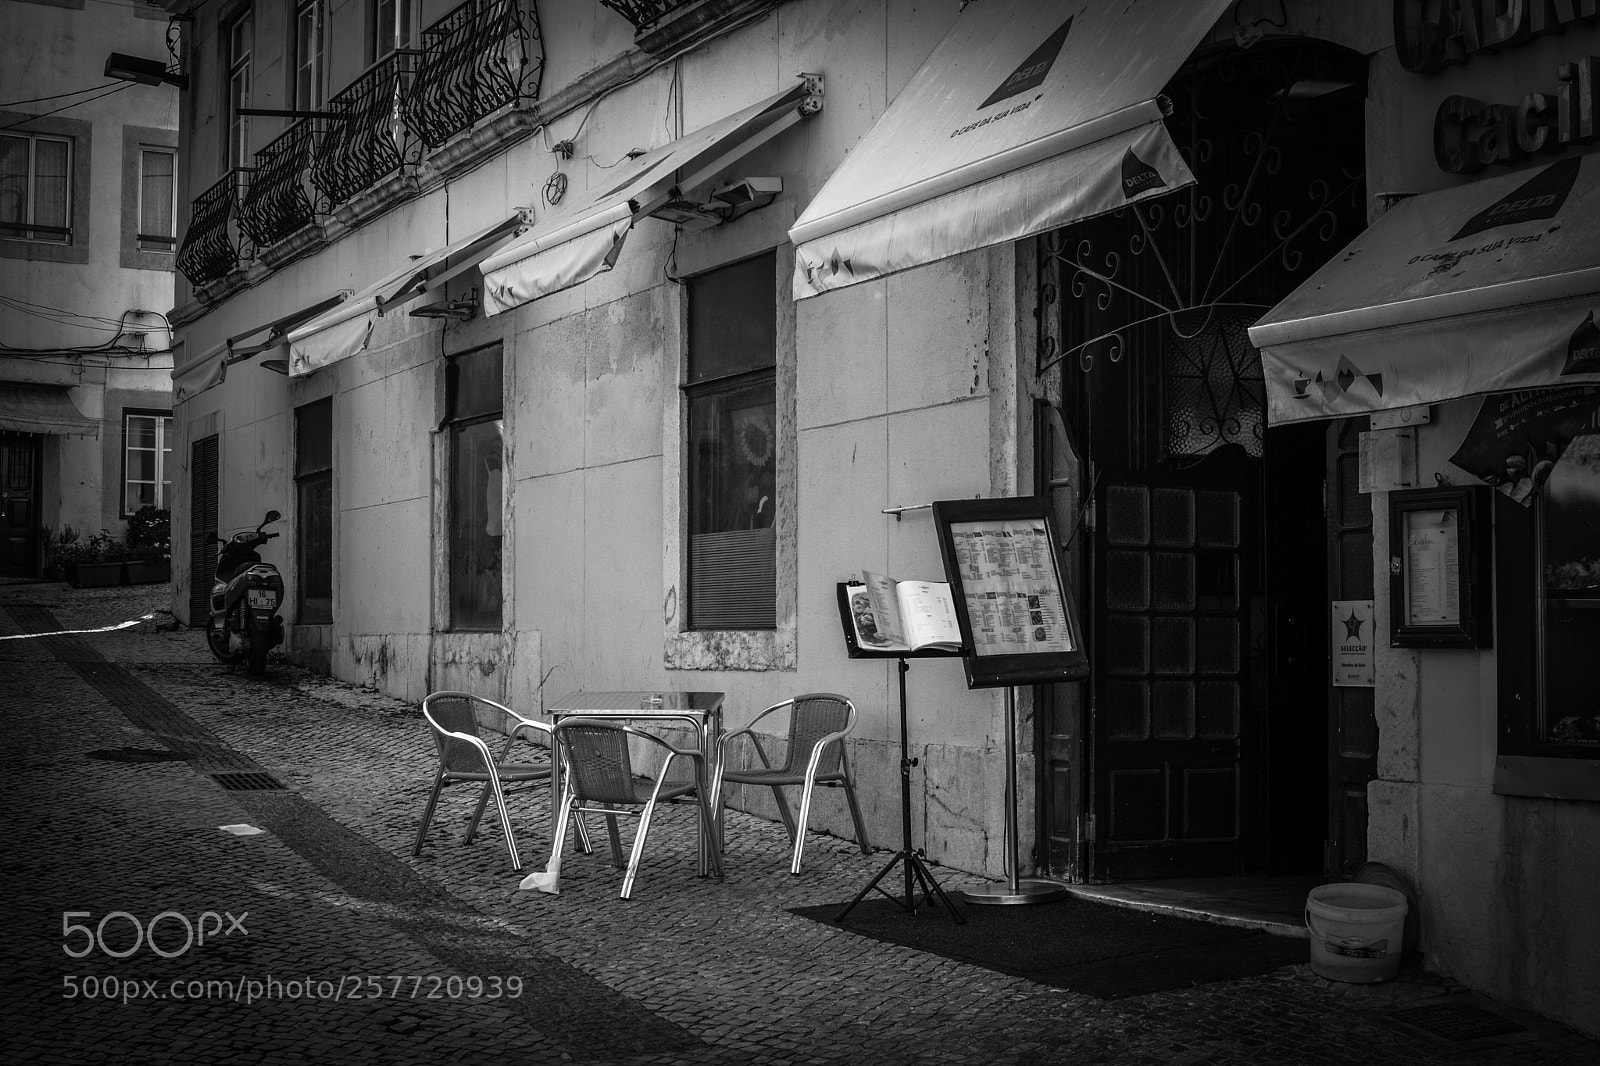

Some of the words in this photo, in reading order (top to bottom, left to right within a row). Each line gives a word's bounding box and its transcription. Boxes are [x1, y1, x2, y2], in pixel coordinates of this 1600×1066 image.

[1124, 170, 1157, 187] DELTA
[1487, 194, 1556, 216] DELTA
[1477, 239, 1504, 255] SUA
[265, 598, 275, 606] 75
